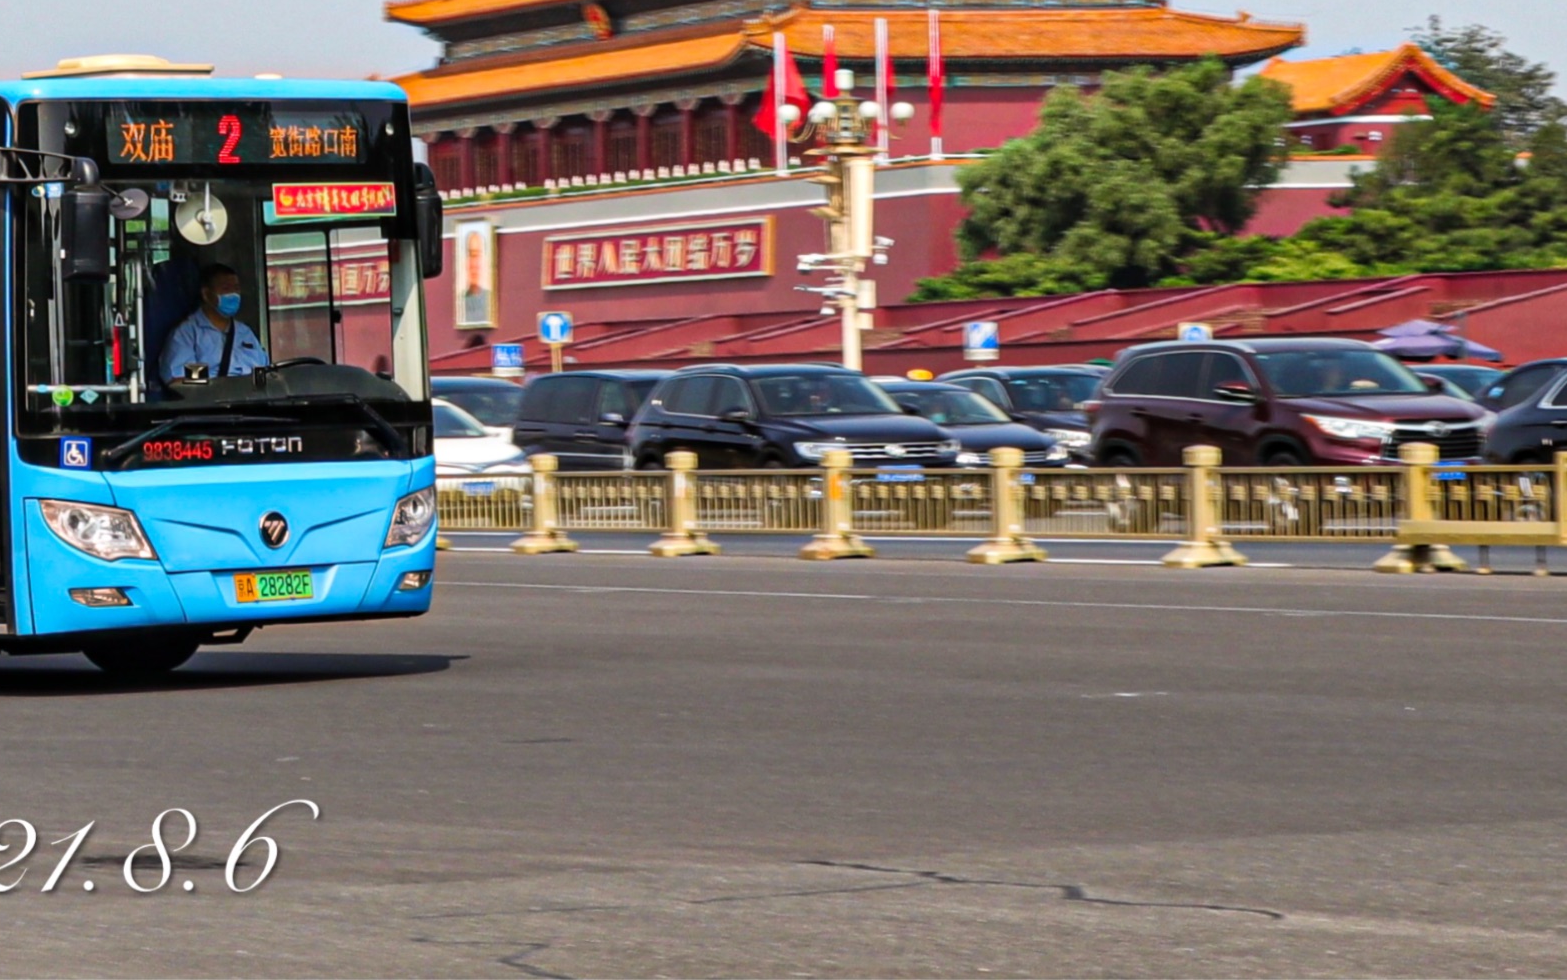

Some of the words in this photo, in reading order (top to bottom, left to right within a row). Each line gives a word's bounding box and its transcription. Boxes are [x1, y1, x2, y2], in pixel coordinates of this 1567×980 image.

[120, 120, 174, 162] 双庙
[218, 114, 242, 164] 2
[269, 125, 358, 158] 宽街路口南
[554, 229, 758, 279] 世界人民大团结万岁
[144, 441, 214, 461] 9838445
